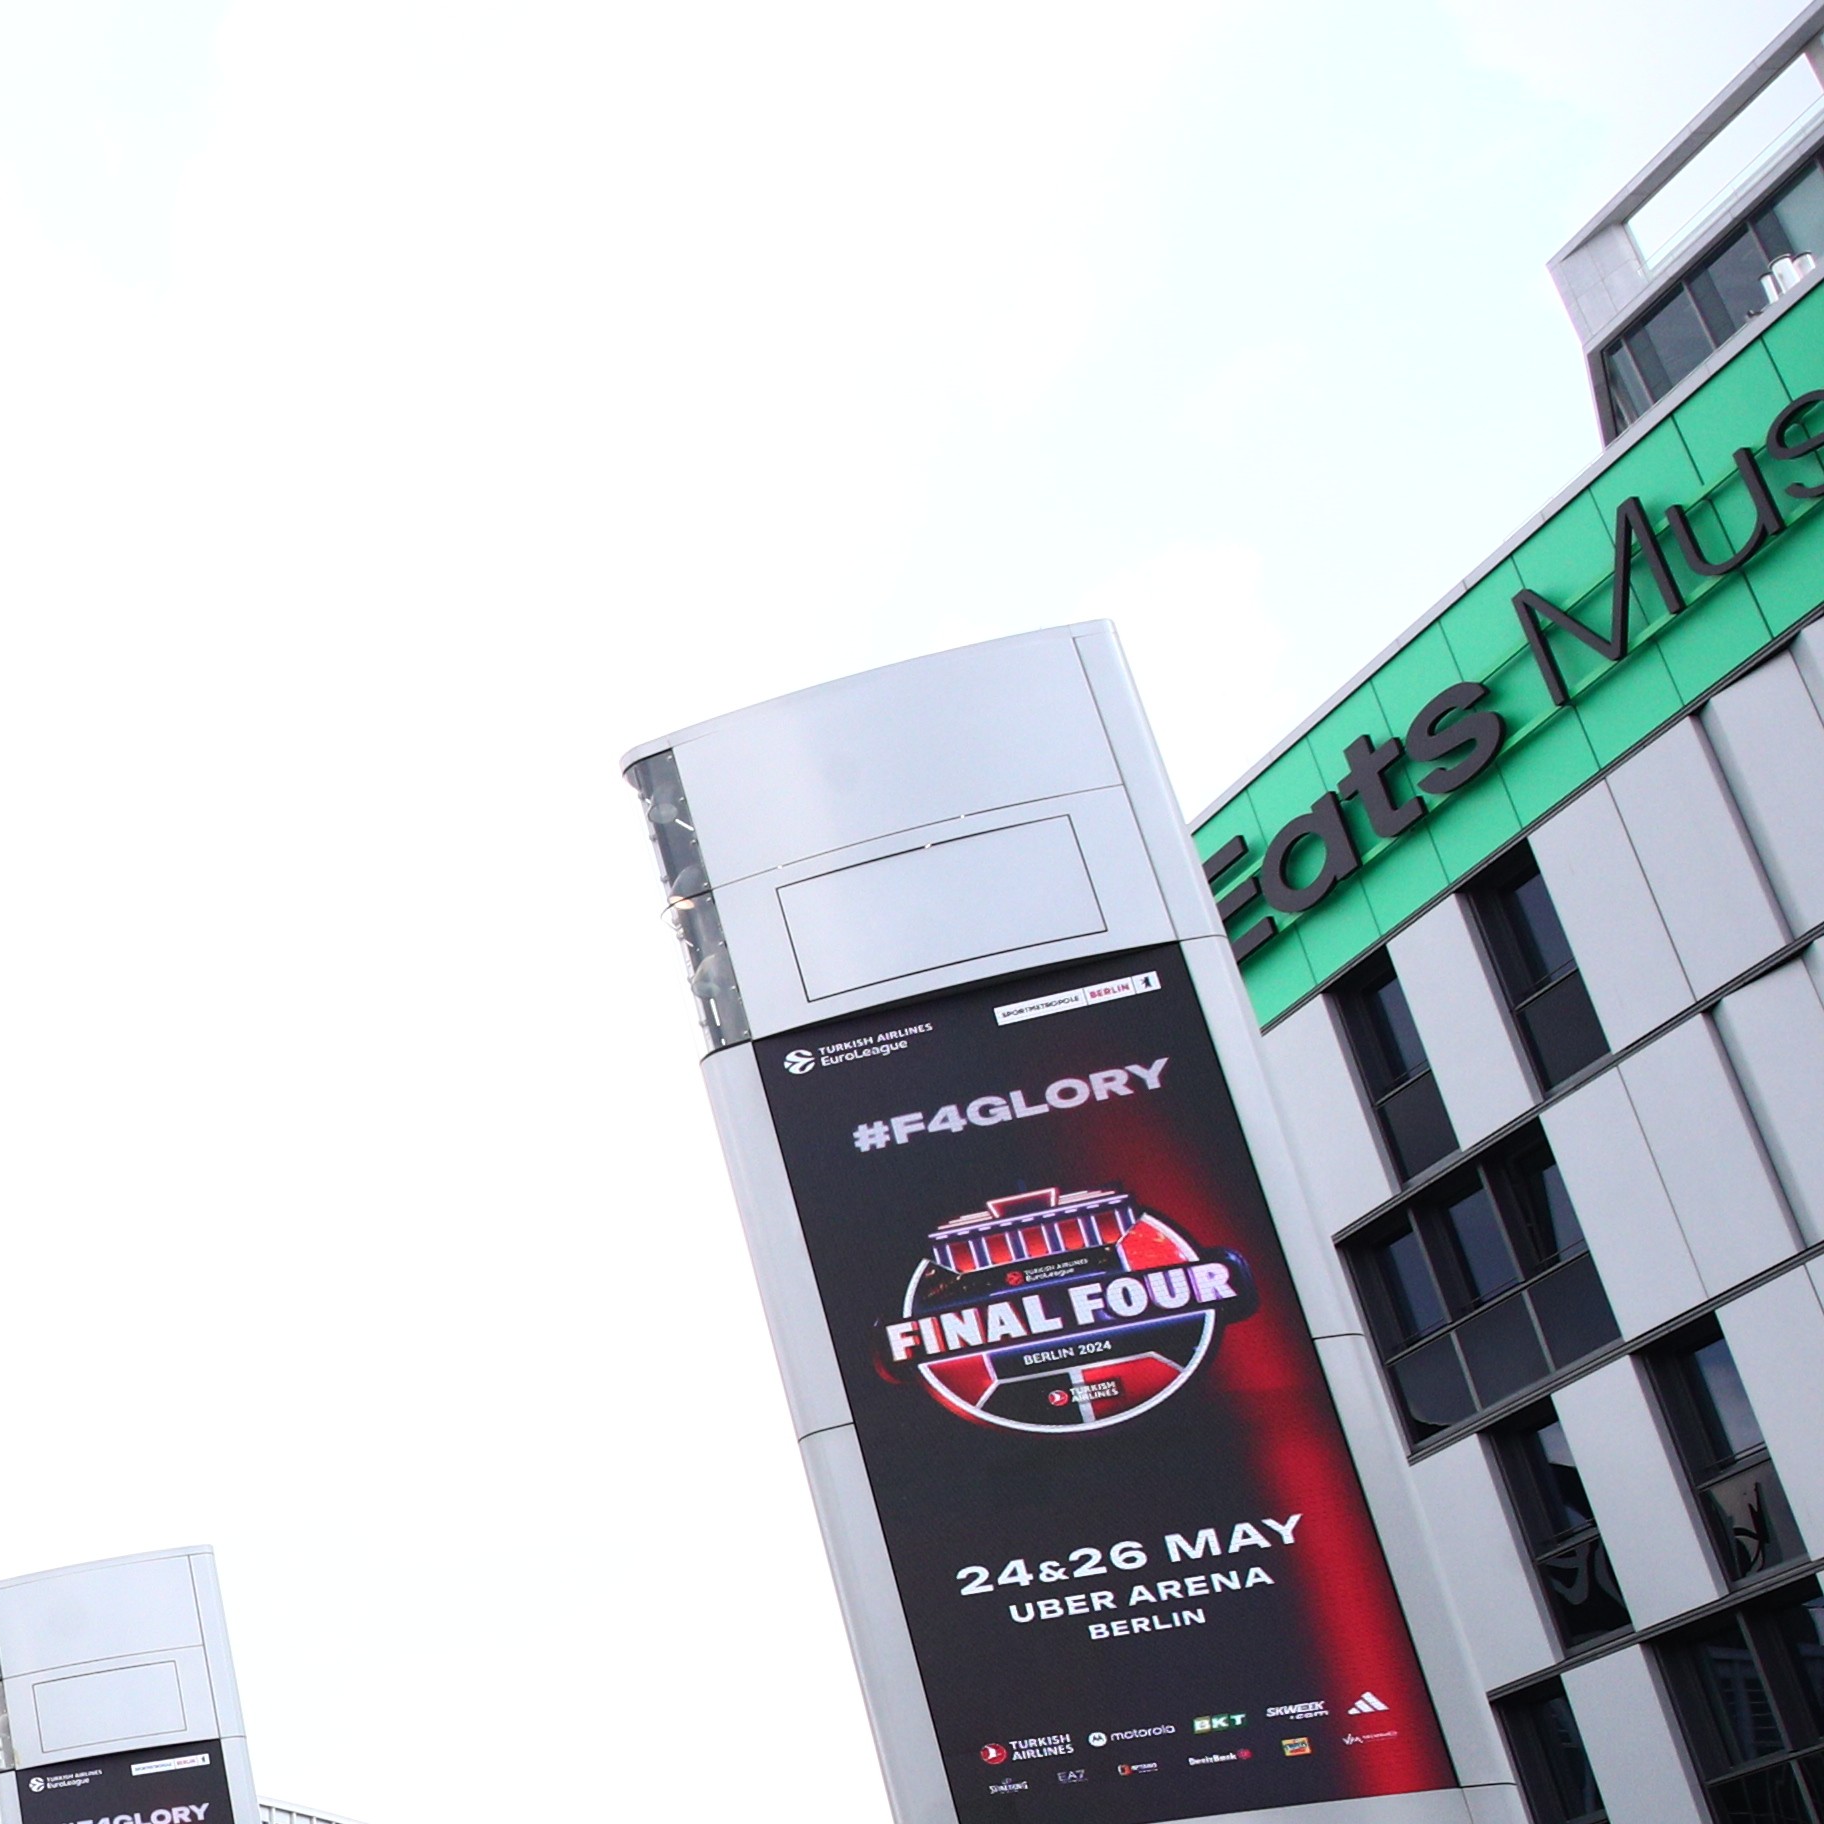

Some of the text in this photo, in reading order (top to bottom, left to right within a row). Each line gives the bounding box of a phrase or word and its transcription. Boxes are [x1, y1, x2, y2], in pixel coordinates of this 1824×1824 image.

[1205, 680, 1505, 962] Eats
[1089, 982, 1130, 1000] BERLIN
[819, 1022, 933, 1055] TURKISH AIRLINES
[821, 1038, 908, 1067] EuroLeague
[852, 1057, 1170, 1152] #F4GLORY
[886, 1262, 1237, 1362] FINAL FOUR
[1023, 1340, 1112, 1366] BERLIN 2024
[956, 1513, 1303, 1596] 24&26 MAY
[1008, 1566, 1275, 1623] UBER ARENA
[1088, 1608, 1207, 1640] BERLIN
[1110, 1724, 1176, 1742] motorola
[1193, 1714, 1247, 1732] BKT
[1009, 1734, 1071, 1750] TURKISH
[1011, 1744, 1074, 1761] AIRLINES
